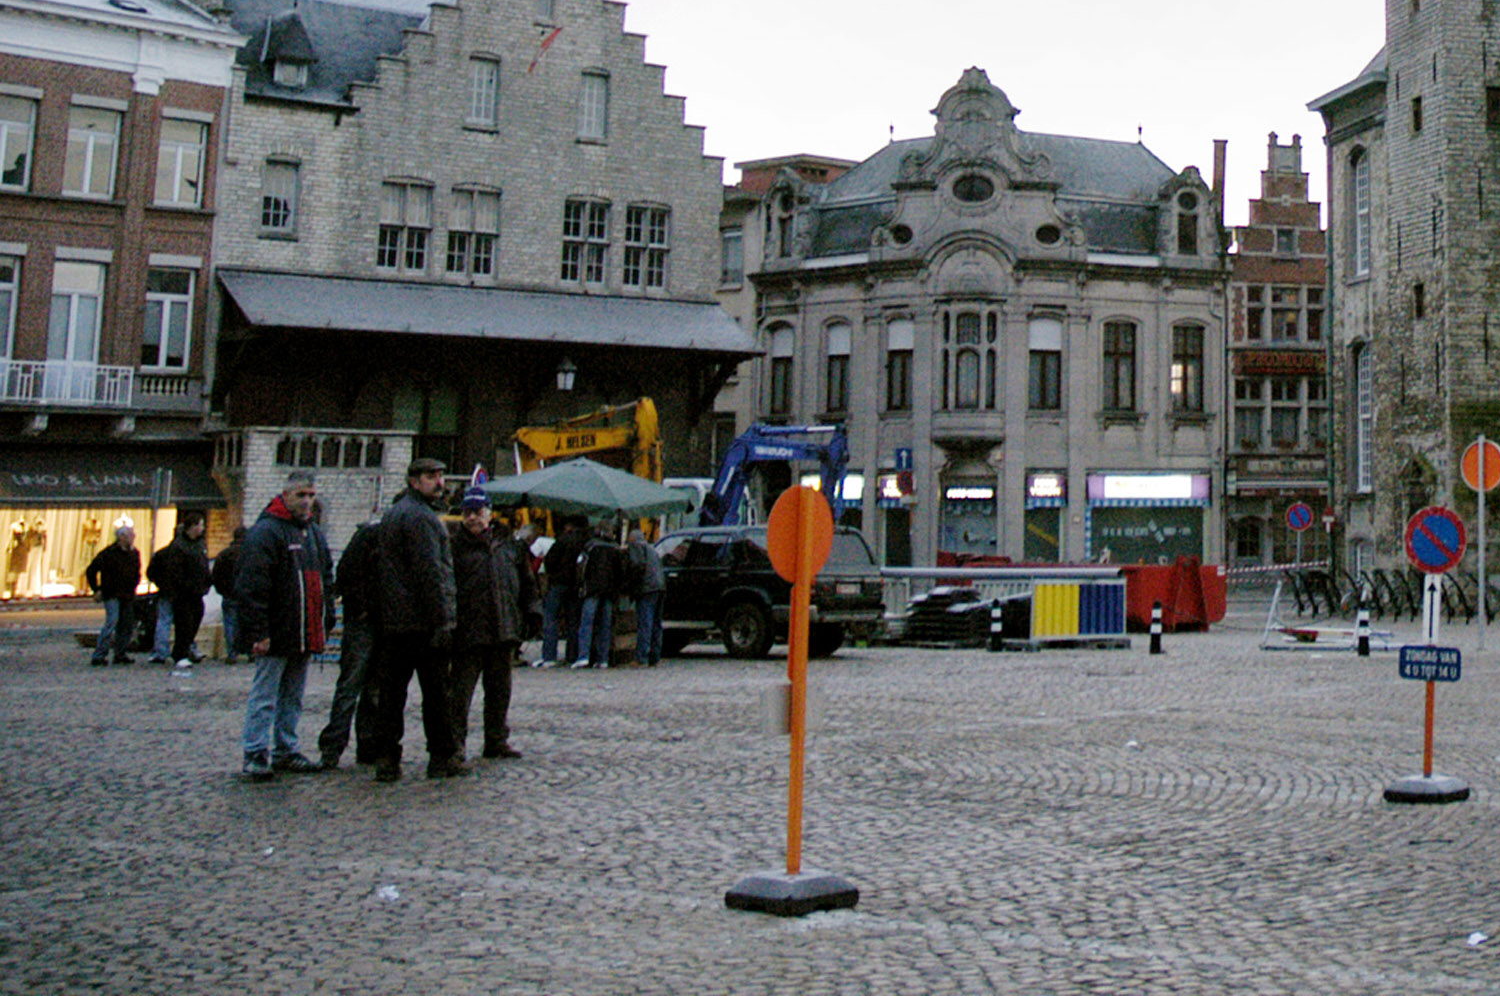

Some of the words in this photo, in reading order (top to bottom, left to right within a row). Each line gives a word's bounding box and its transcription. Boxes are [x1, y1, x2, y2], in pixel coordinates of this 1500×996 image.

[1405, 648, 1438, 662] ZONDAG
[1439, 650, 1458, 664] VAN
[1404, 664, 1411, 676] 4
[1421, 664, 1437, 678] TOT
